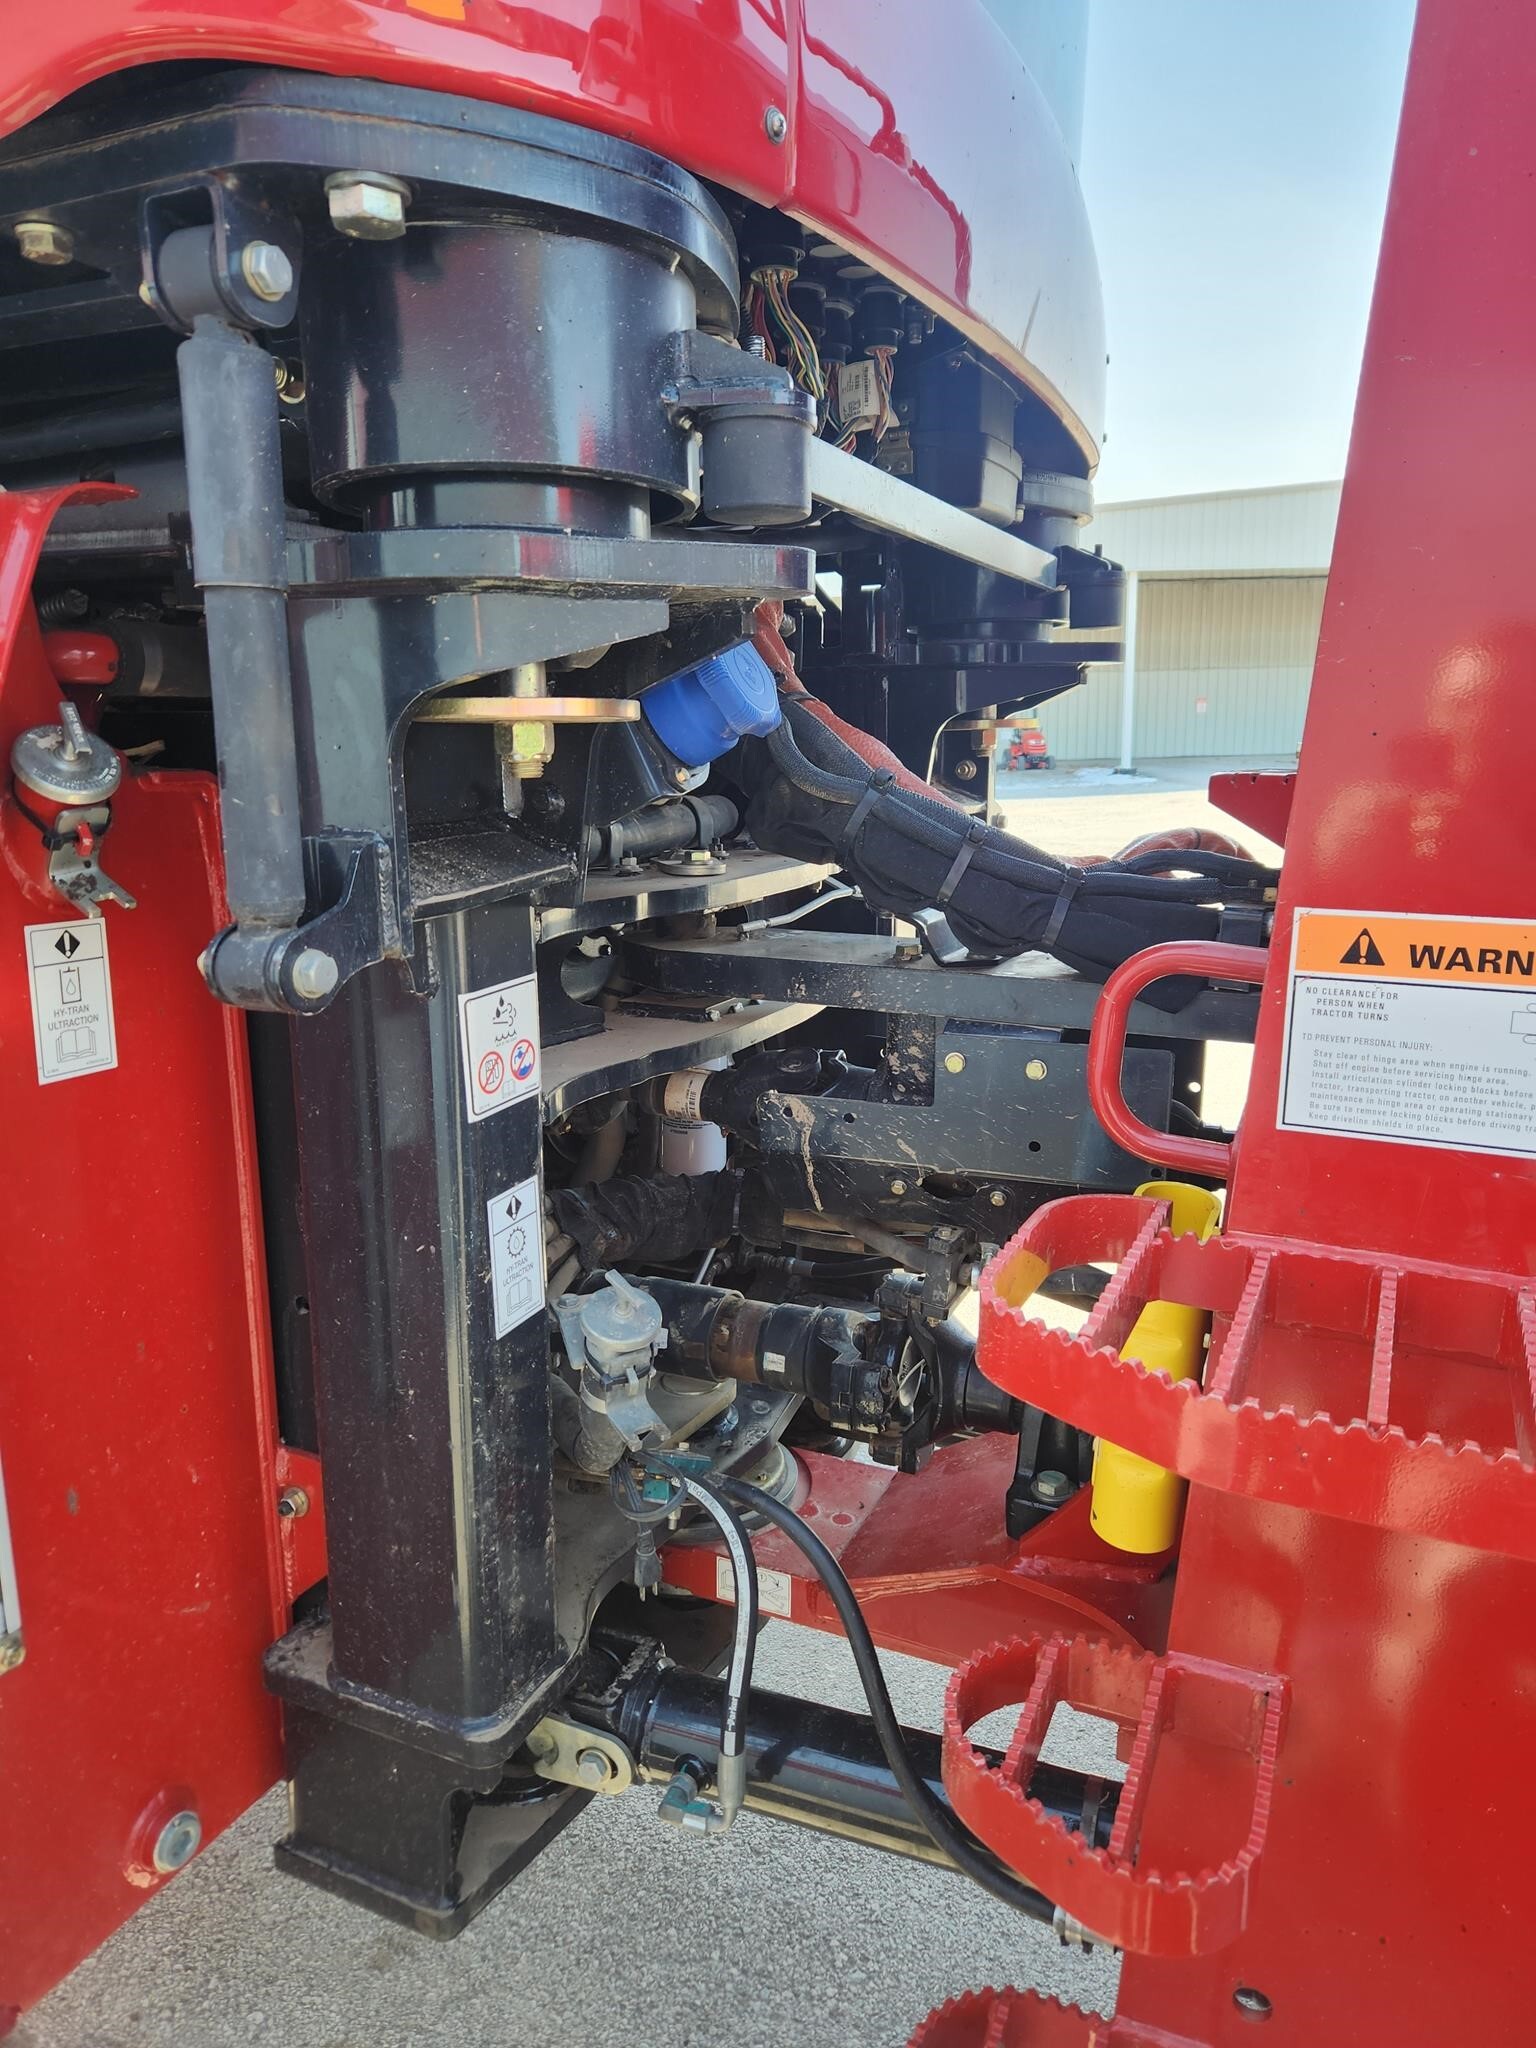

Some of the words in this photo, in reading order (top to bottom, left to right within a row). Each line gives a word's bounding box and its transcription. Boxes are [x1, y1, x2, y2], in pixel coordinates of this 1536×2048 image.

[1409, 943, 1535, 977] WARN
[1306, 986, 1318, 994] NO
[1322, 987, 1377, 999] CLEARANCE
[1380, 991, 1399, 1000] FOR
[53, 1004, 90, 1018] HY-TRAN
[1316, 997, 1354, 1007] PERSON
[1357, 1001, 1385, 1010] WHEN
[47, 1013, 99, 1031] ULTRACTION
[1311, 1008, 1354, 1018] TRACTOR
[1357, 1012, 1390, 1021] TURNS
[1302, 1032, 1313, 1041] TO
[1314, 1033, 1351, 1044] PREVENT
[1353, 1037, 1397, 1049] PERSONAL
[1399, 1041, 1433, 1051] INJURY:
[1313, 1048, 1332, 1059] Stay
[1336, 1051, 1358, 1060] clear
[1361, 1054, 1370, 1062] of
[1373, 1054, 1396, 1065] hinge
[1400, 1058, 1419, 1066] area
[1423, 1060, 1446, 1068] when
[1449, 1063, 1479, 1073] engine
[1482, 1064, 1490, 1072] is
[1312, 1059, 1332, 1068] Shut
[1335, 1062, 1348, 1070] off
[1351, 1065, 1380, 1074] engine
[1383, 1066, 1411, 1076] before
[1414, 1070, 1455, 1081] servicing
[1458, 1073, 1483, 1084] hinge
[1311, 1070, 1340, 1080] Install
[1342, 1074, 1393, 1085] articulation
[1395, 1079, 1431, 1089] cylinder
[1435, 1082, 1468, 1093] locking
[1470, 1086, 1500, 1095] blocks
[1503, 1089, 1533, 1098] before
[1347, 1084, 1401, 1097] transporting
[1453, 1095, 1488, 1105] another
[1309, 1101, 1320, 1109] Be
[1344, 1105, 1353, 1113] to
[1356, 1108, 1387, 1117] remove
[1390, 1110, 1422, 1121] locking
[1425, 1114, 1454, 1124] blocks
[1457, 1117, 1486, 1127] before
[1489, 1121, 1522, 1132] driving
[1366, 1096, 1374, 1104] in
[1377, 1098, 1401, 1108] hinge
[1404, 1101, 1423, 1110] area
[1439, 1106, 1482, 1117] operating
[1486, 1109, 1533, 1122] stationary
[1308, 1112, 1328, 1121] Keep
[1331, 1114, 1368, 1124] driveline
[1372, 1119, 1402, 1129] shields
